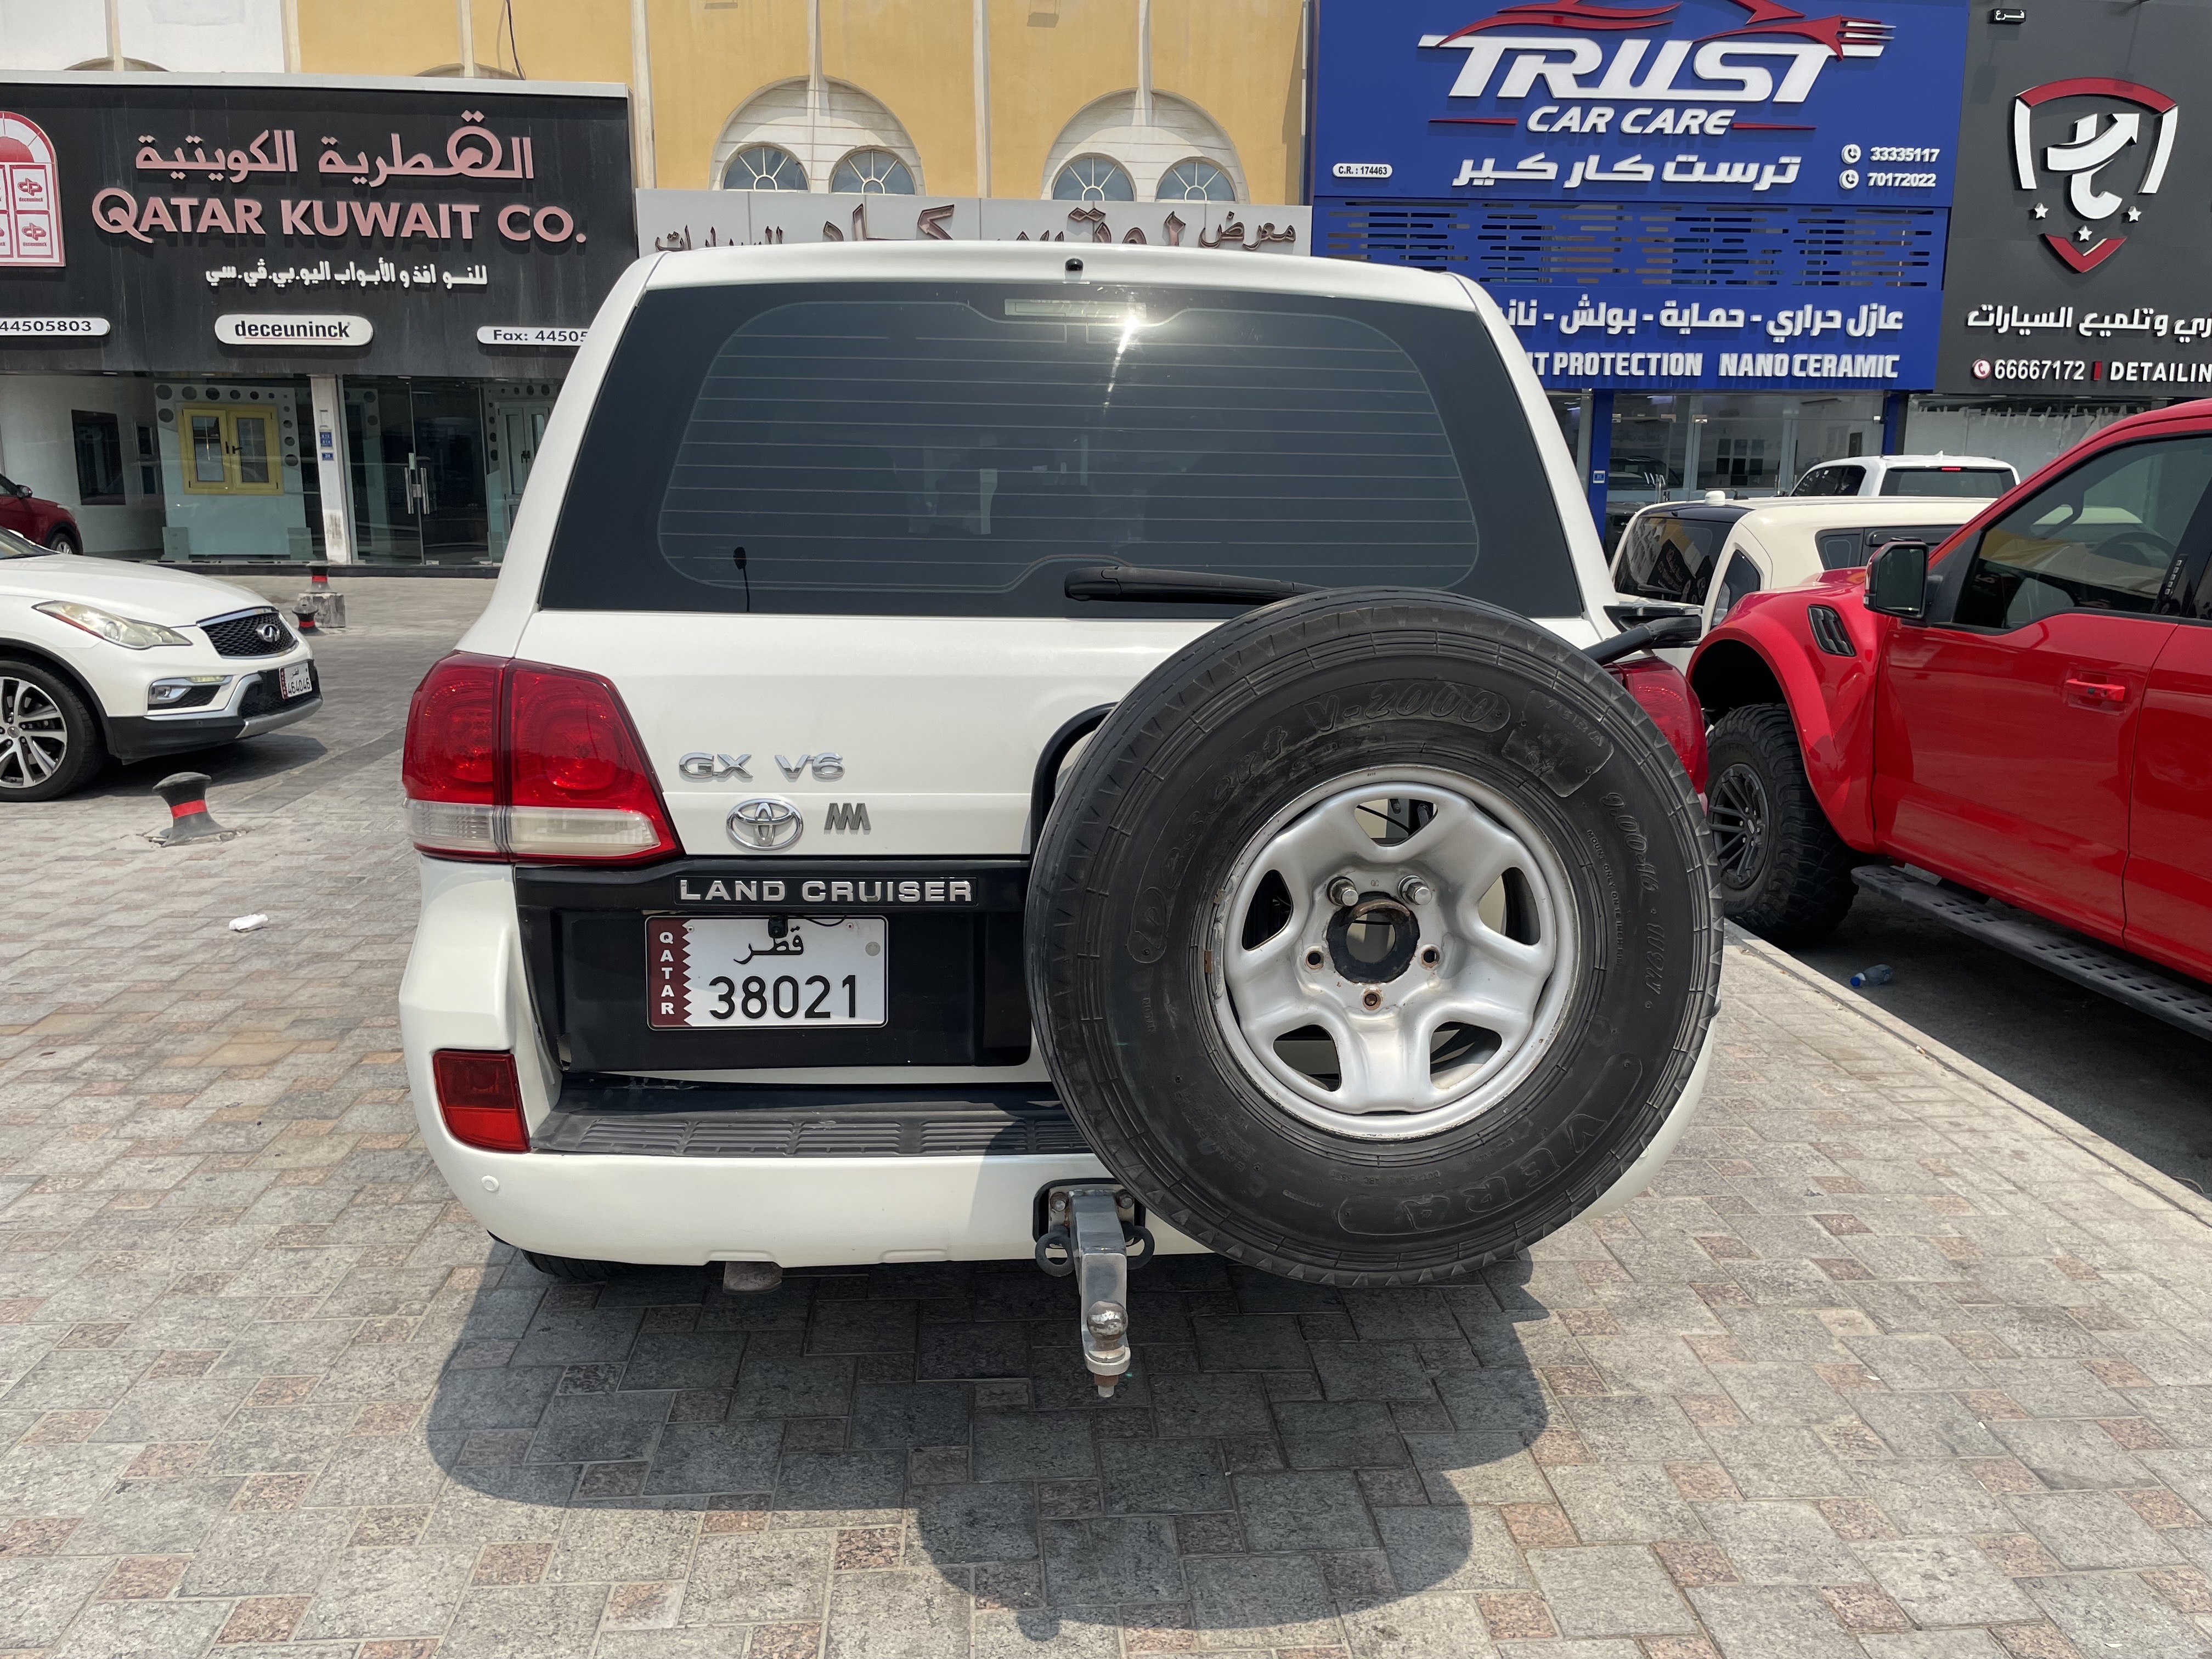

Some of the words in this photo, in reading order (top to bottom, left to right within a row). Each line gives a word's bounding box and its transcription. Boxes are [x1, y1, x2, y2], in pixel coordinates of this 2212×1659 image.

[1417, 35, 1884, 103] TRUST
[1527, 105, 1615, 134] CAR
[1620, 107, 1736, 136] CARE
[136, 129, 298, 183] الكويتية
[1361, 166, 1387, 174] 174463
[1452, 152, 1558, 187] كير
[1870, 146, 1940, 162] 33335117
[1563, 154, 1655, 188] كار
[1661, 154, 1802, 191] ترست
[1867, 172, 1936, 188] 70172022
[91, 187, 267, 244] QATAR
[280, 199, 481, 240] KUWAIT
[497, 204, 587, 244] CO.
[1198, 211, 1296, 251] معرض
[0, 321, 92, 332] 44505803
[234, 320, 350, 338] deceuninck
[1560, 294, 1637, 335] بولش
[1660, 300, 1745, 335] حماية
[1766, 304, 1842, 343] حراري
[1846, 303, 1903, 337] عازل
[1967, 304, 2073, 335] السيارات
[2079, 308, 2168, 337] وتلميع
[493, 329, 528, 341] Fax:
[1552, 352, 1703, 376] PROTECTION
[1718, 353, 1790, 377] NANO
[1791, 354, 1900, 378] CERAMIC
[1994, 359, 2085, 380] 66667172
[288, 677, 311, 695] 464046
[679, 752, 754, 780] GX
[774, 752, 845, 780] V6
[679, 879, 786, 901] LAND
[802, 880, 973, 903] CRUISER
[733, 925, 804, 964] قطر
[659, 932, 675, 1015] QATAR
[708, 974, 857, 1019] 38021
